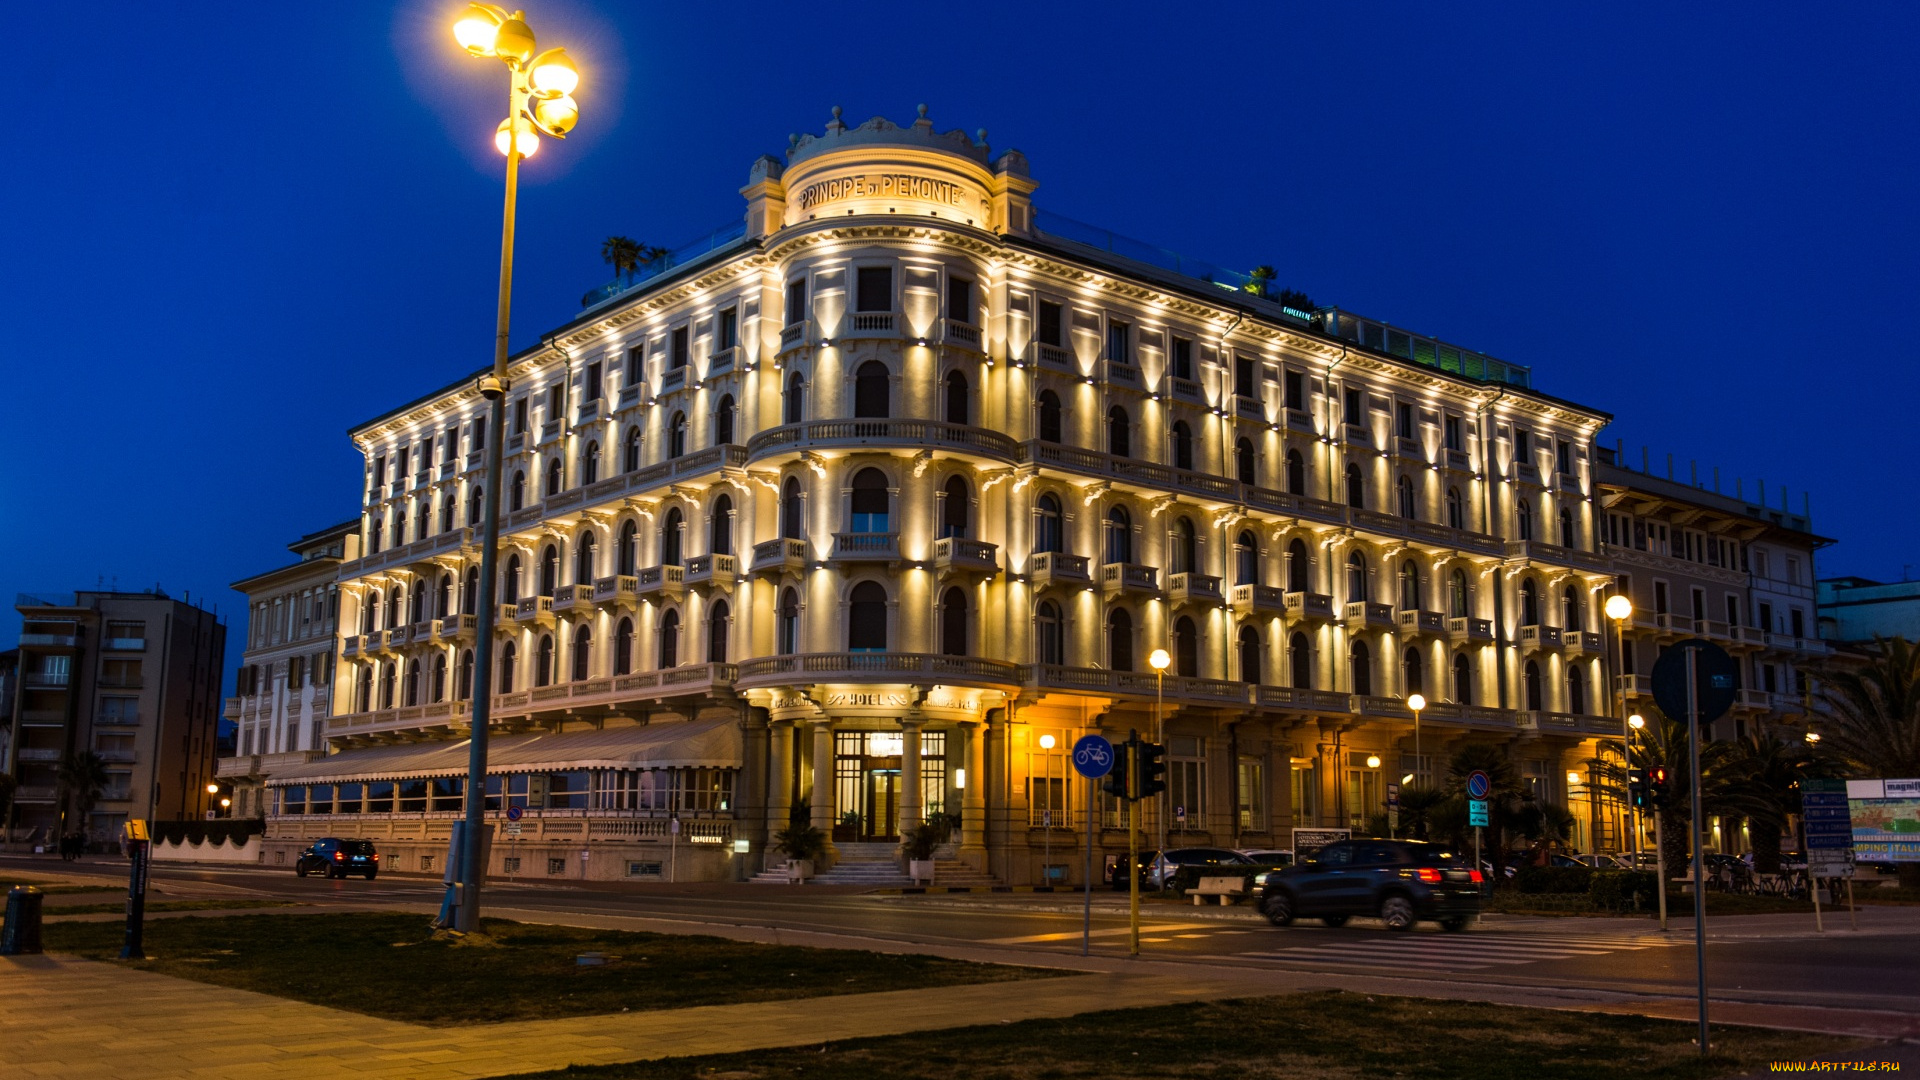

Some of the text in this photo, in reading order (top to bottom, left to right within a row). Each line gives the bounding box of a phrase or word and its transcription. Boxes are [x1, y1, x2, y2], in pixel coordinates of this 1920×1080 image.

[800, 176, 865, 208] PRINCIPE
[882, 176, 960, 204] PIEMONTE
[849, 693, 885, 706] HOTEL
[1177, 806, 1183, 816] P
